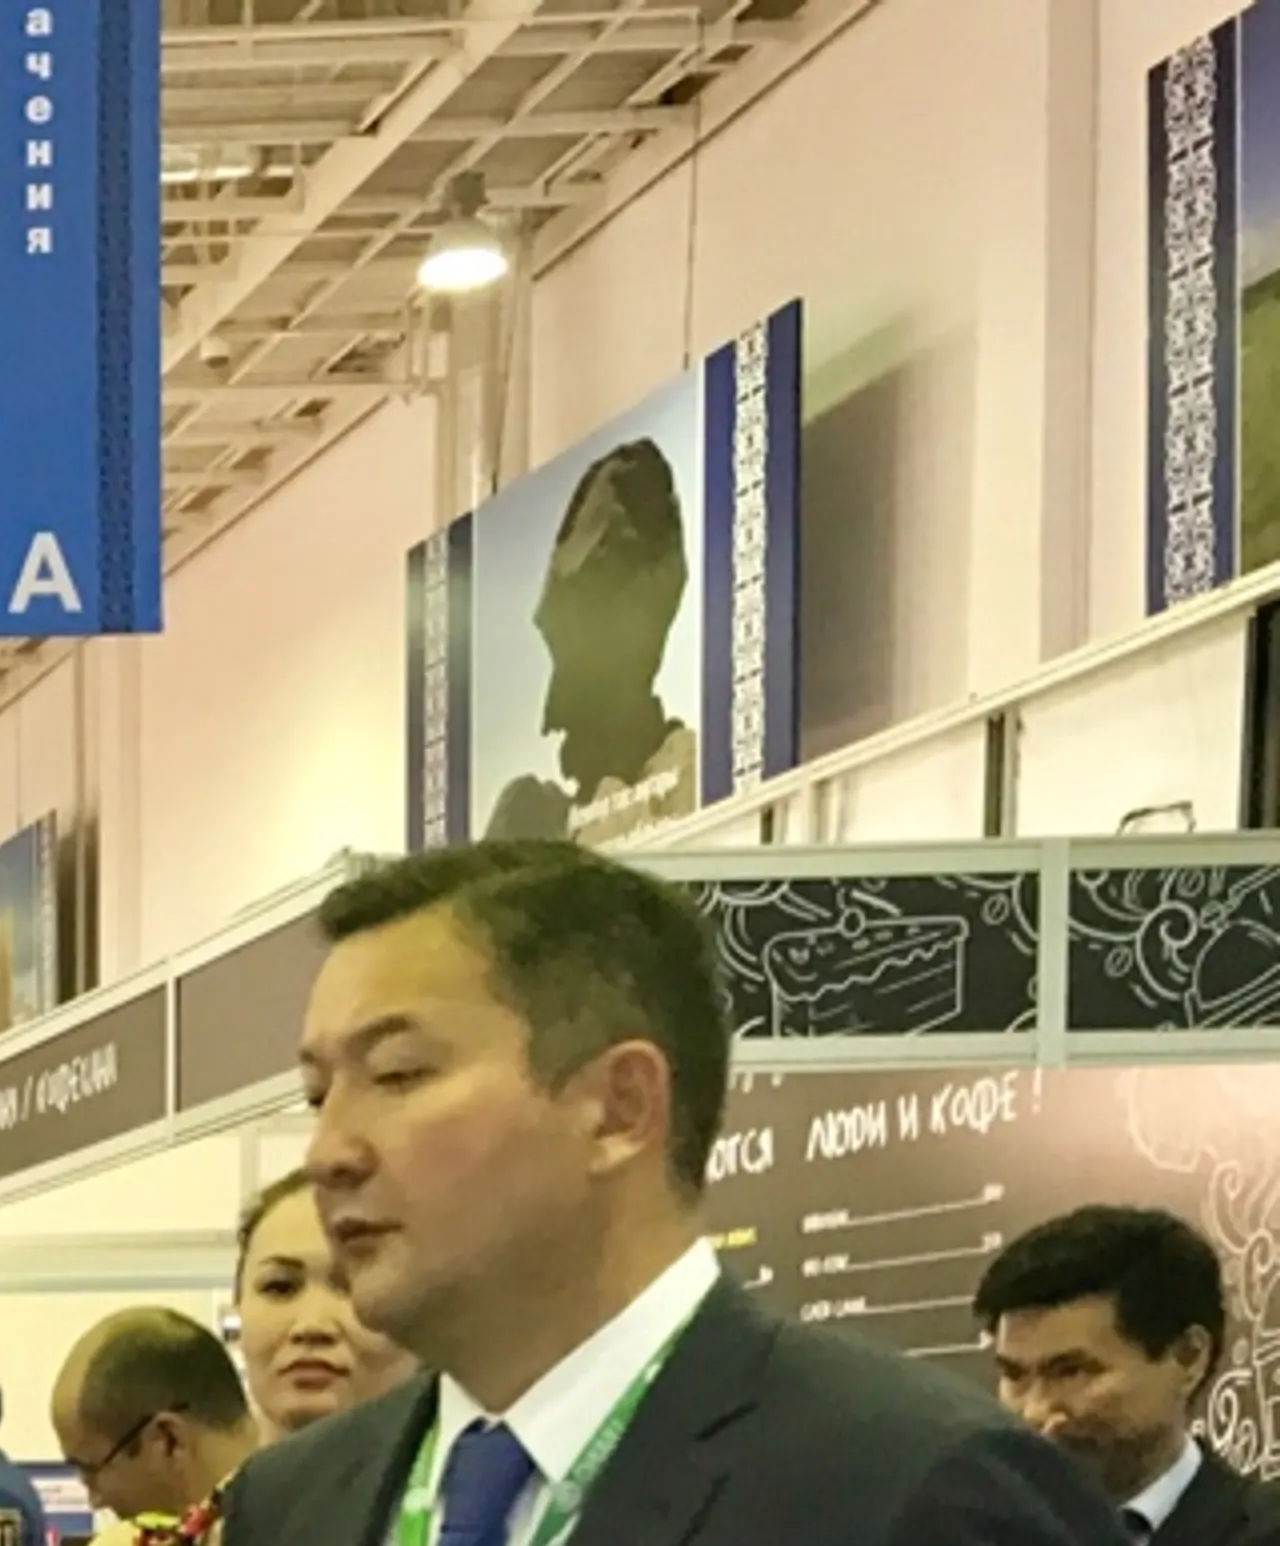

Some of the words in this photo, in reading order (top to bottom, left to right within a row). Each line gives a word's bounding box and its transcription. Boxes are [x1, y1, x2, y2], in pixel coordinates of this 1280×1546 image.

[24, 7, 54, 254] ачения
[806, 1100, 886, 1162] ЛЮДИ
[899, 1093, 920, 1142] И
[930, 1071, 1019, 1136] КОФЕ
